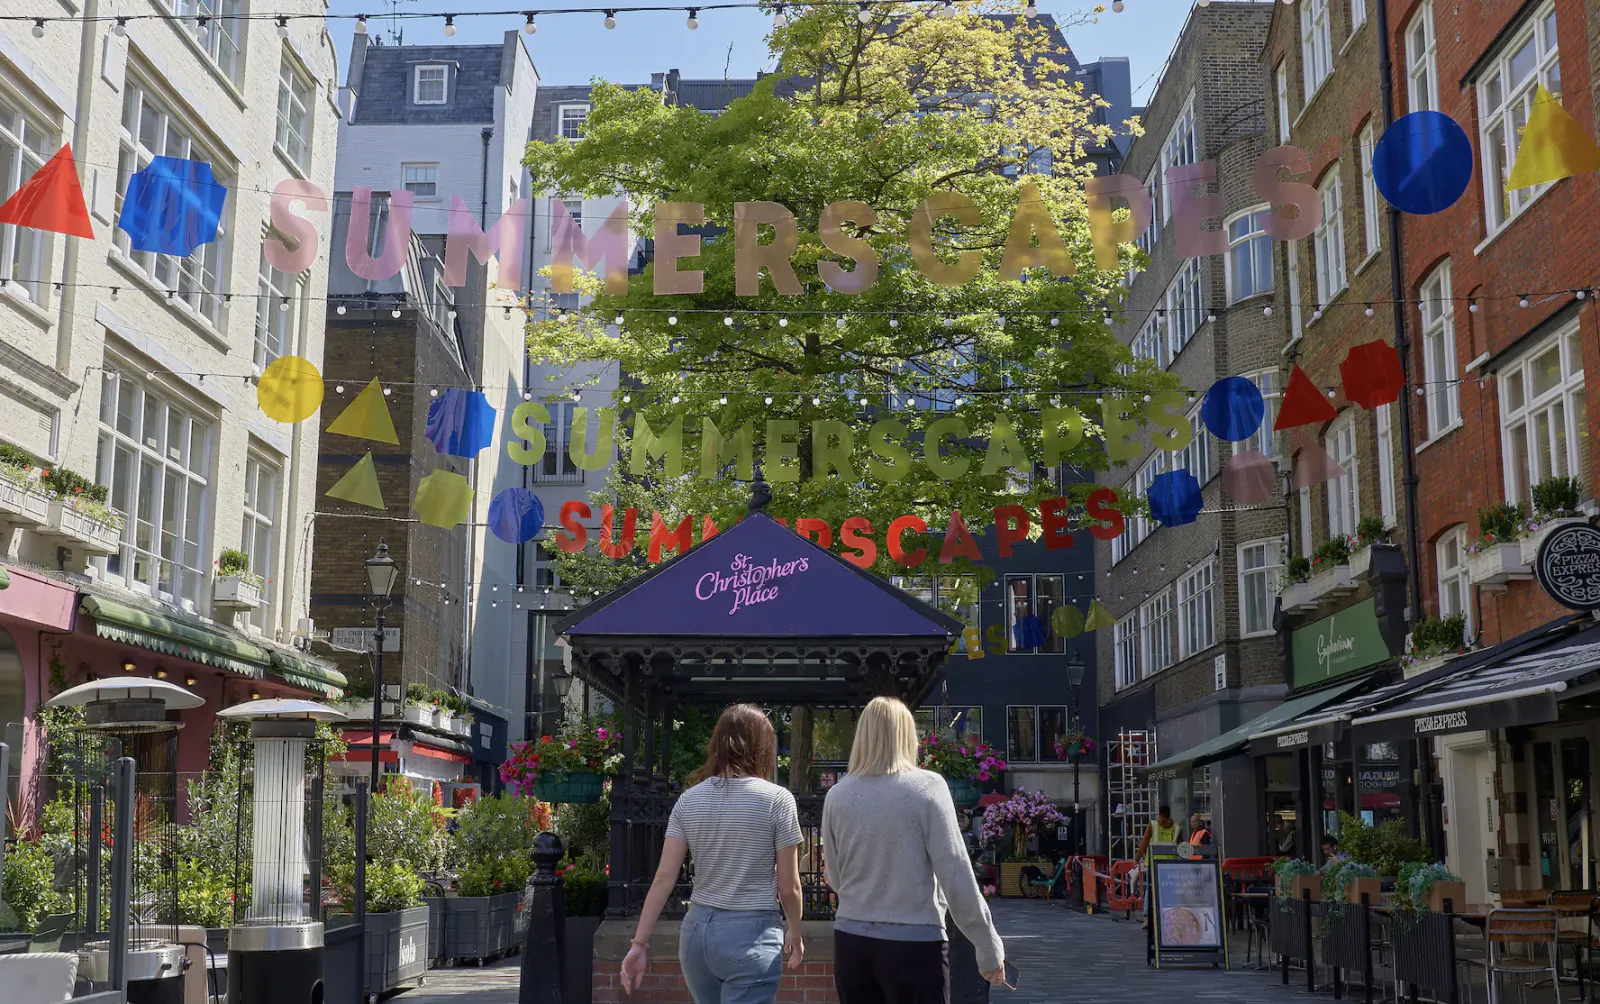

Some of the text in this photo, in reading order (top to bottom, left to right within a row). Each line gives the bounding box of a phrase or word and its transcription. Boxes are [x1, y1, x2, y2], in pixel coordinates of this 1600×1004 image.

[264, 145, 1323, 297] SUMMERSCAPES
[507, 396, 1193, 483] SUMMERSCAPES
[555, 488, 1125, 570] SUMRSCAPES
[695, 557, 809, 600] Christopher's
[730, 553, 752, 571] St
[1561, 553, 1600, 565] PIZZA
[729, 586, 778, 615] Place
